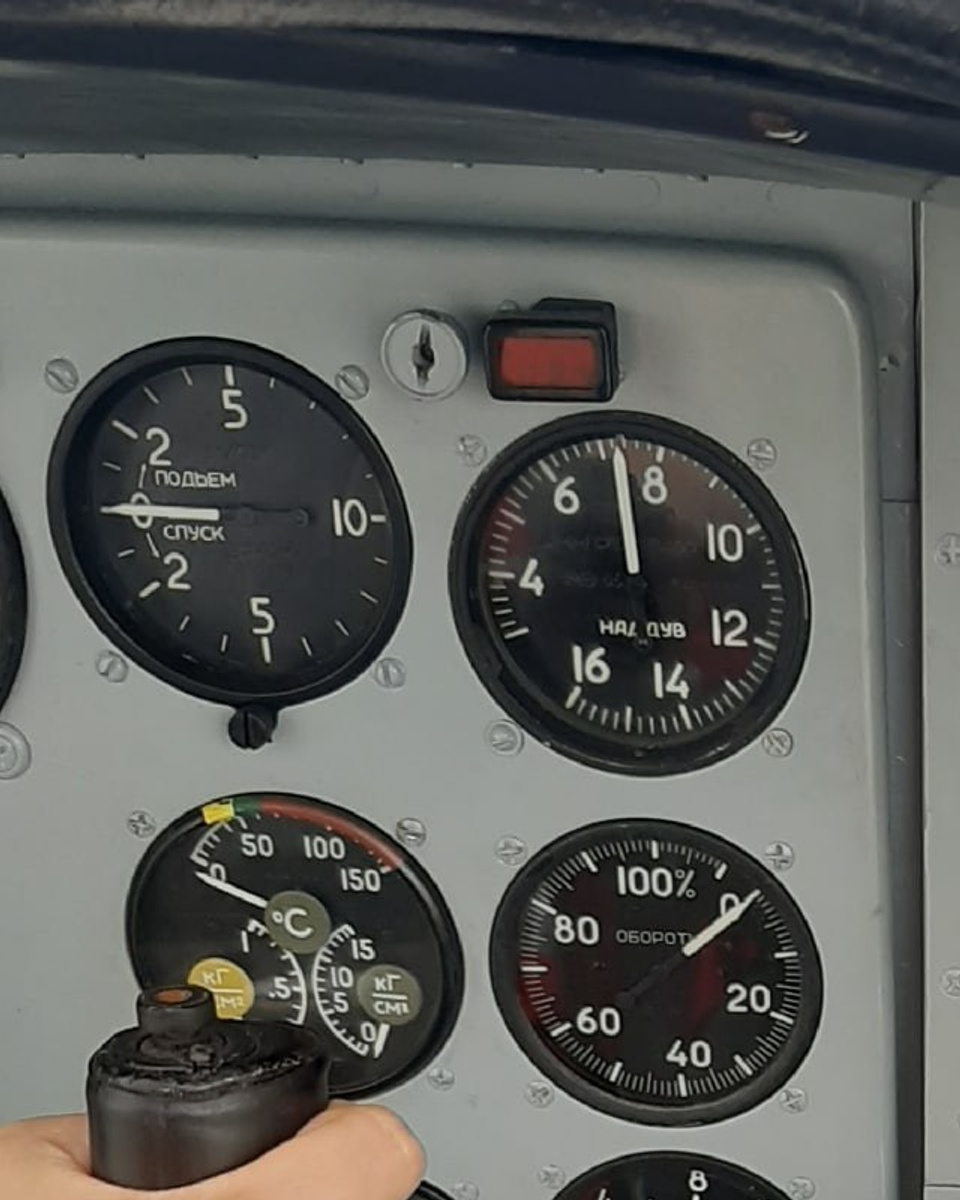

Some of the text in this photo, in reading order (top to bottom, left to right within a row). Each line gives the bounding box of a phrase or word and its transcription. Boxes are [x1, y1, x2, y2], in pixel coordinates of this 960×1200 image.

[221, 388, 249, 429] 5
[146, 427, 172, 466] 2
[553, 476, 581, 515] 6
[641, 465, 668, 505] 8
[162, 525, 226, 542] СПУСК
[332, 498, 368, 538] 10
[706, 523, 744, 563] 10
[163, 552, 192, 590] 2
[519, 558, 545, 597] 4
[250, 597, 276, 635] 5
[711, 608, 749, 648] 12
[572, 645, 612, 684] 16
[653, 661, 690, 700] 14
[241, 833, 274, 857] 50
[304, 836, 346, 860] 100
[340, 867, 381, 893] 150
[616, 865, 697, 899] 100%
[553, 915, 601, 945] 80
[615, 929, 698, 946] ОБОРОТ
[351, 938, 377, 961] 15
[330, 966, 354, 988] 10
[333, 992, 349, 1014] 5
[726, 982, 772, 1014] 20
[359, 1021, 376, 1043] 0
[576, 1006, 621, 1036] 60
[665, 1039, 712, 1068] 40
[688, 1169, 709, 1193] 8
